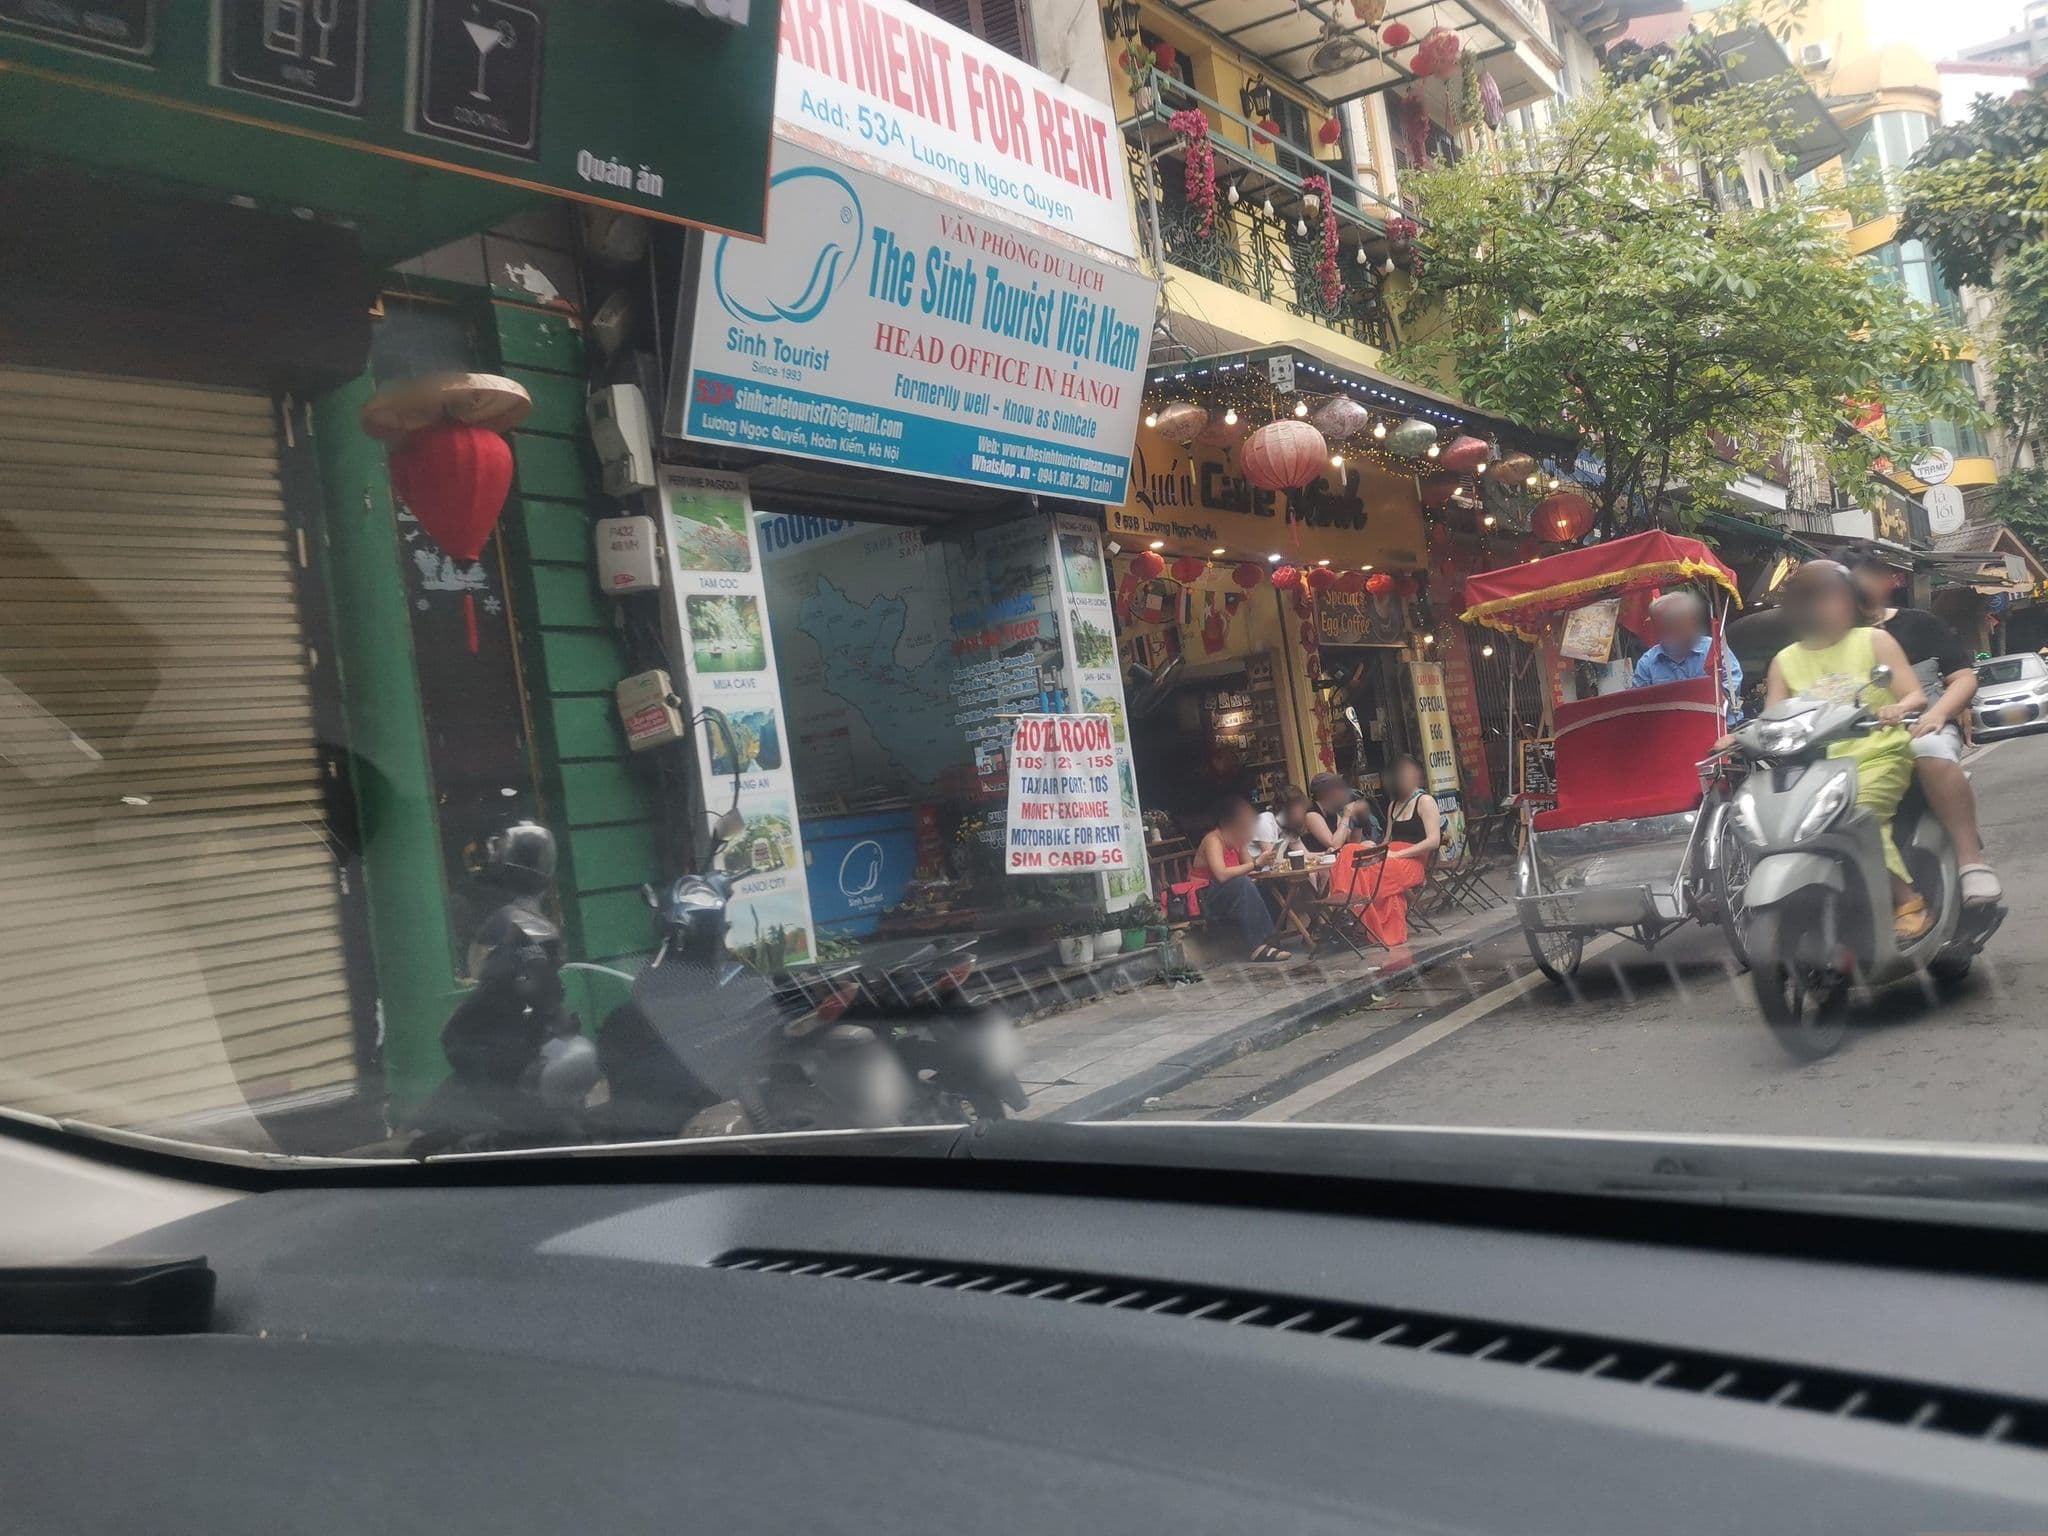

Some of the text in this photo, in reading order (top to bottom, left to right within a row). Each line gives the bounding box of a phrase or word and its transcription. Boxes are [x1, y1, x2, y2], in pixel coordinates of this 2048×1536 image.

[962, 52, 1033, 166] FOR
[1033, 88, 1112, 201] RENT
[801, 89, 1073, 221] Add: 53A Luong Ngoc Quyen
[939, 214, 1104, 292] VĂN PHÒNG DU LỊCH
[869, 226, 1140, 372] The Sinh Tourist Việt Nam
[727, 327, 830, 372] Sinh Tourist
[752, 361, 802, 381] Since 1993
[874, 321, 1121, 409] HEAD OFFICE IN HANOI
[735, 386, 903, 439] sinhcafetourist76@gmail.com
[963, 391, 990, 416] well
[1002, 398, 1032, 424] Know
[1037, 409, 1050, 429] as
[1052, 410, 1097, 439] SinhCafe
[811, 432, 838, 450] Hoàn
[868, 442, 882, 457] Hà
[884, 445, 900, 463] Nội
[978, 435, 1000, 455] Web:
[972, 454, 1016, 478] WhatsApp
[1091, 476, 1113, 495] (zalo)
[760, 513, 855, 552] TOURIS
[700, 577, 738, 589] TAM COC
[1321, 611, 1370, 636] Egg Coffee
[734, 678, 757, 688] CAVE
[1419, 696, 1445, 712] SPECIAL
[1060, 719, 1111, 752] ROOM
[1430, 724, 1443, 740] EGG
[1087, 755, 1114, 769] 15$
[1429, 751, 1452, 768] COFFEE
[756, 778, 769, 788] AN
[1061, 776, 1087, 794] PORT:
[1089, 774, 1109, 794] 10$
[1021, 802, 1056, 820] MONEY
[1058, 801, 1109, 819] EXCHANGE
[1011, 828, 1071, 846] MOTORBIKE
[1074, 827, 1093, 845] FOR
[1095, 825, 1120, 843] RENT
[1011, 849, 1123, 867] SIM CARD 5G
[768, 878, 786, 890] CITY
